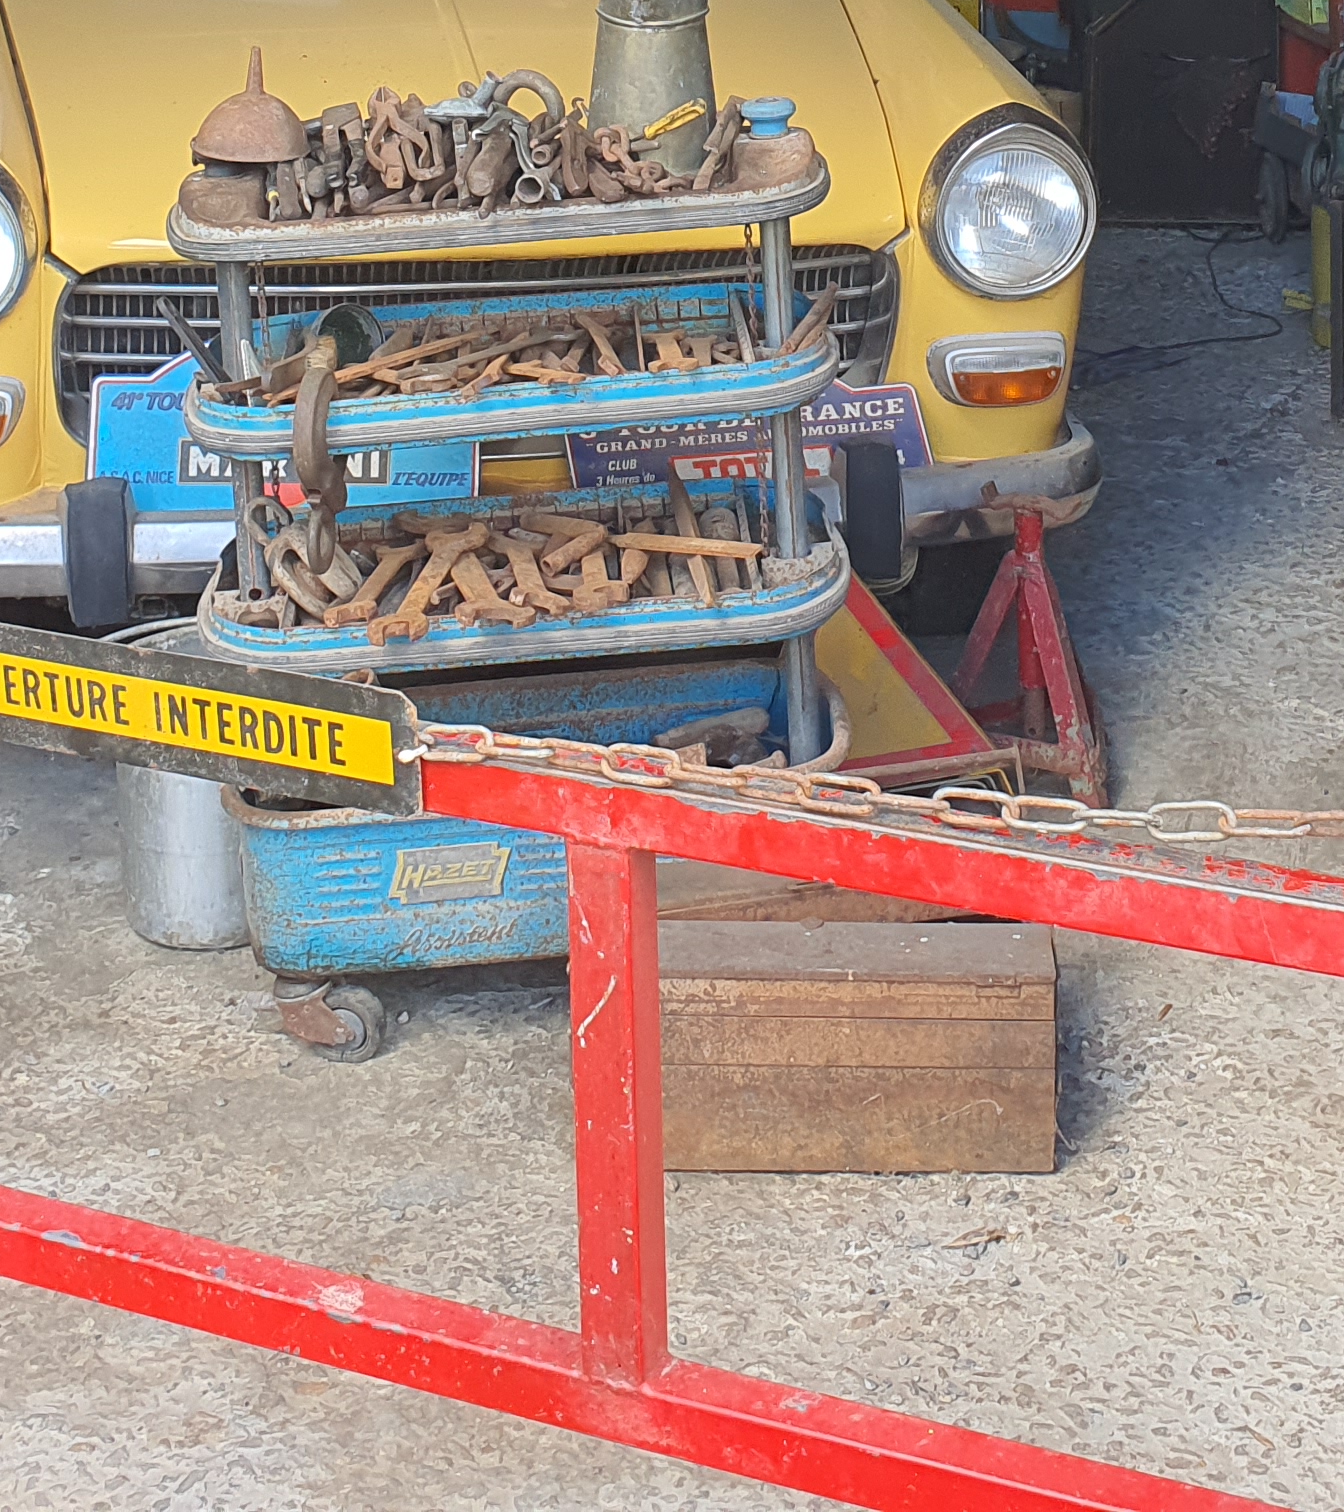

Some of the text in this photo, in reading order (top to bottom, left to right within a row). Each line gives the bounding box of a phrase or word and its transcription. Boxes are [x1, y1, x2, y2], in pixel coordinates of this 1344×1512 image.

[800, 397, 906, 421] RANCE
[146, 470, 174, 484] NICE
[608, 459, 637, 471] CLUB
[153, 691, 348, 766] INTERDITE
[399, 856, 501, 890] HAZET
